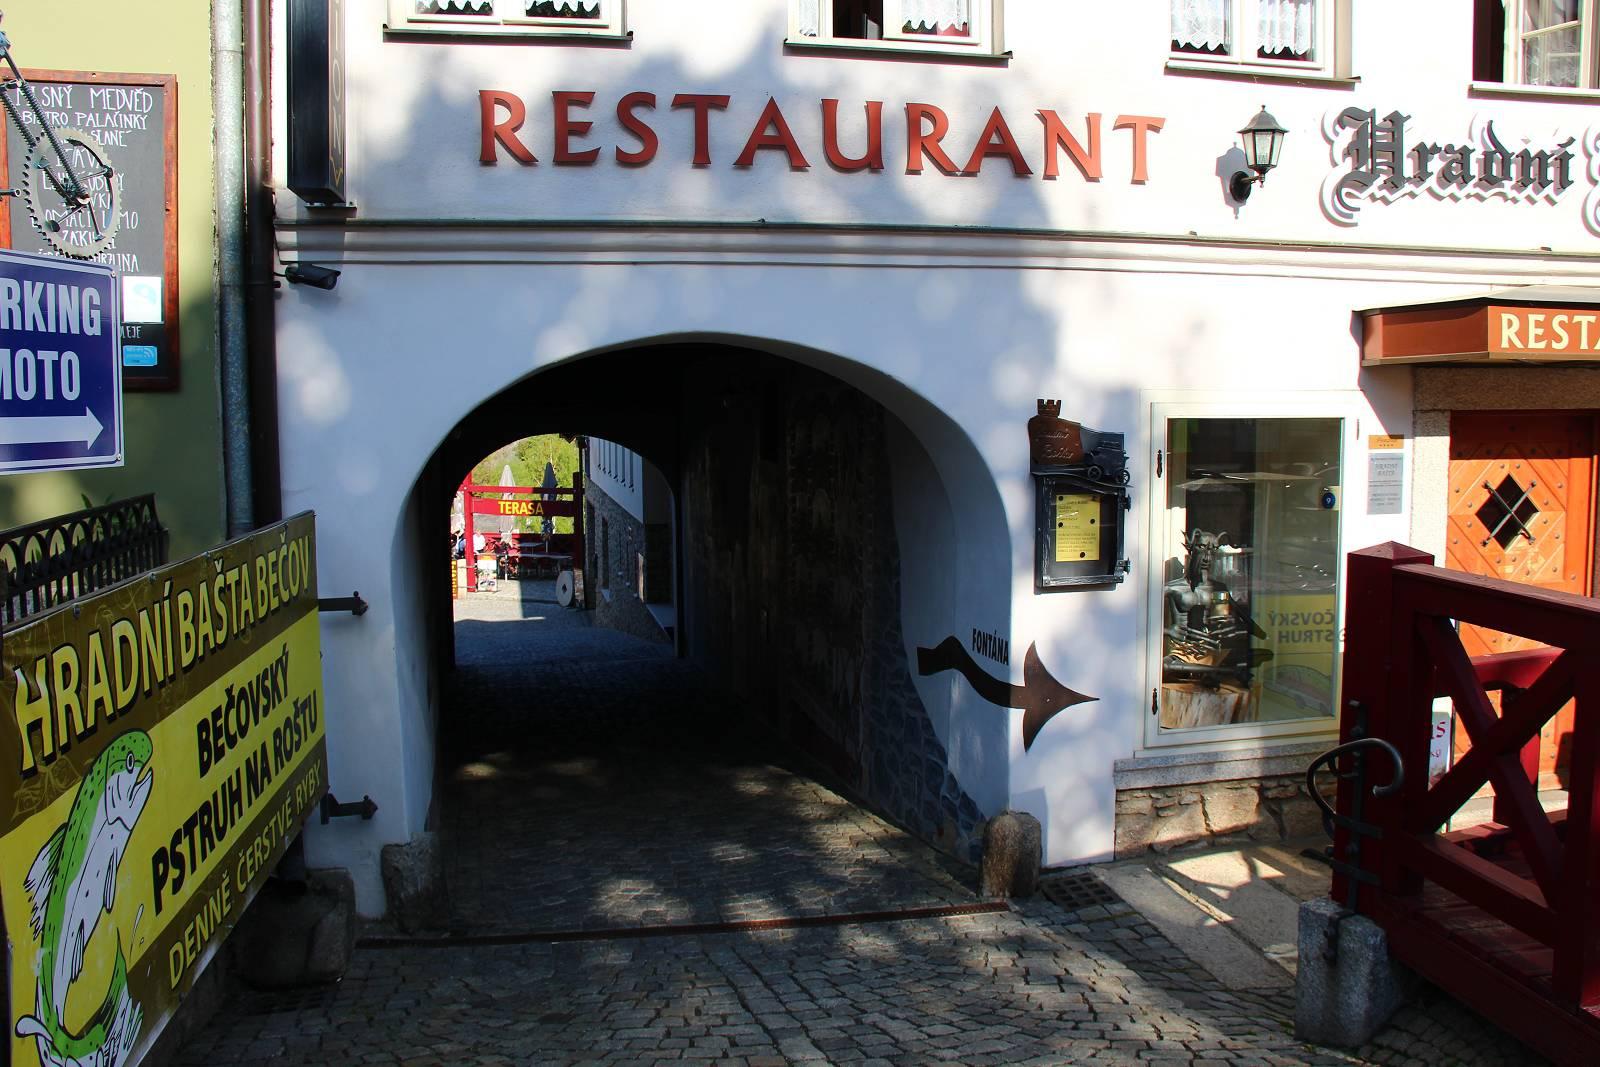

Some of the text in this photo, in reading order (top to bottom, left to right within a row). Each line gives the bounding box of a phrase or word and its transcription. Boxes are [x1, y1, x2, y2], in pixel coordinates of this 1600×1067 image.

[75, 111, 148, 130] PALAČINKY
[90, 87, 153, 113] MEDVĚD
[479, 90, 1166, 181] RESTAURANT
[1331, 106, 1576, 212] Hradní
[0, 277, 101, 336] RKING
[1500, 313, 1600, 350] REST
[498, 501, 544, 515] TERASA
[14, 531, 310, 773] HRADNÍ BAŠTA BEČOV
[972, 627, 1009, 666] FONTÁNA
[197, 643, 289, 779] BEČOVSKÝ
[152, 689, 318, 917] PSTRUH NA ROŠTU
[169, 759, 321, 989] DENNĚ ČERSTVÉ RYBY
